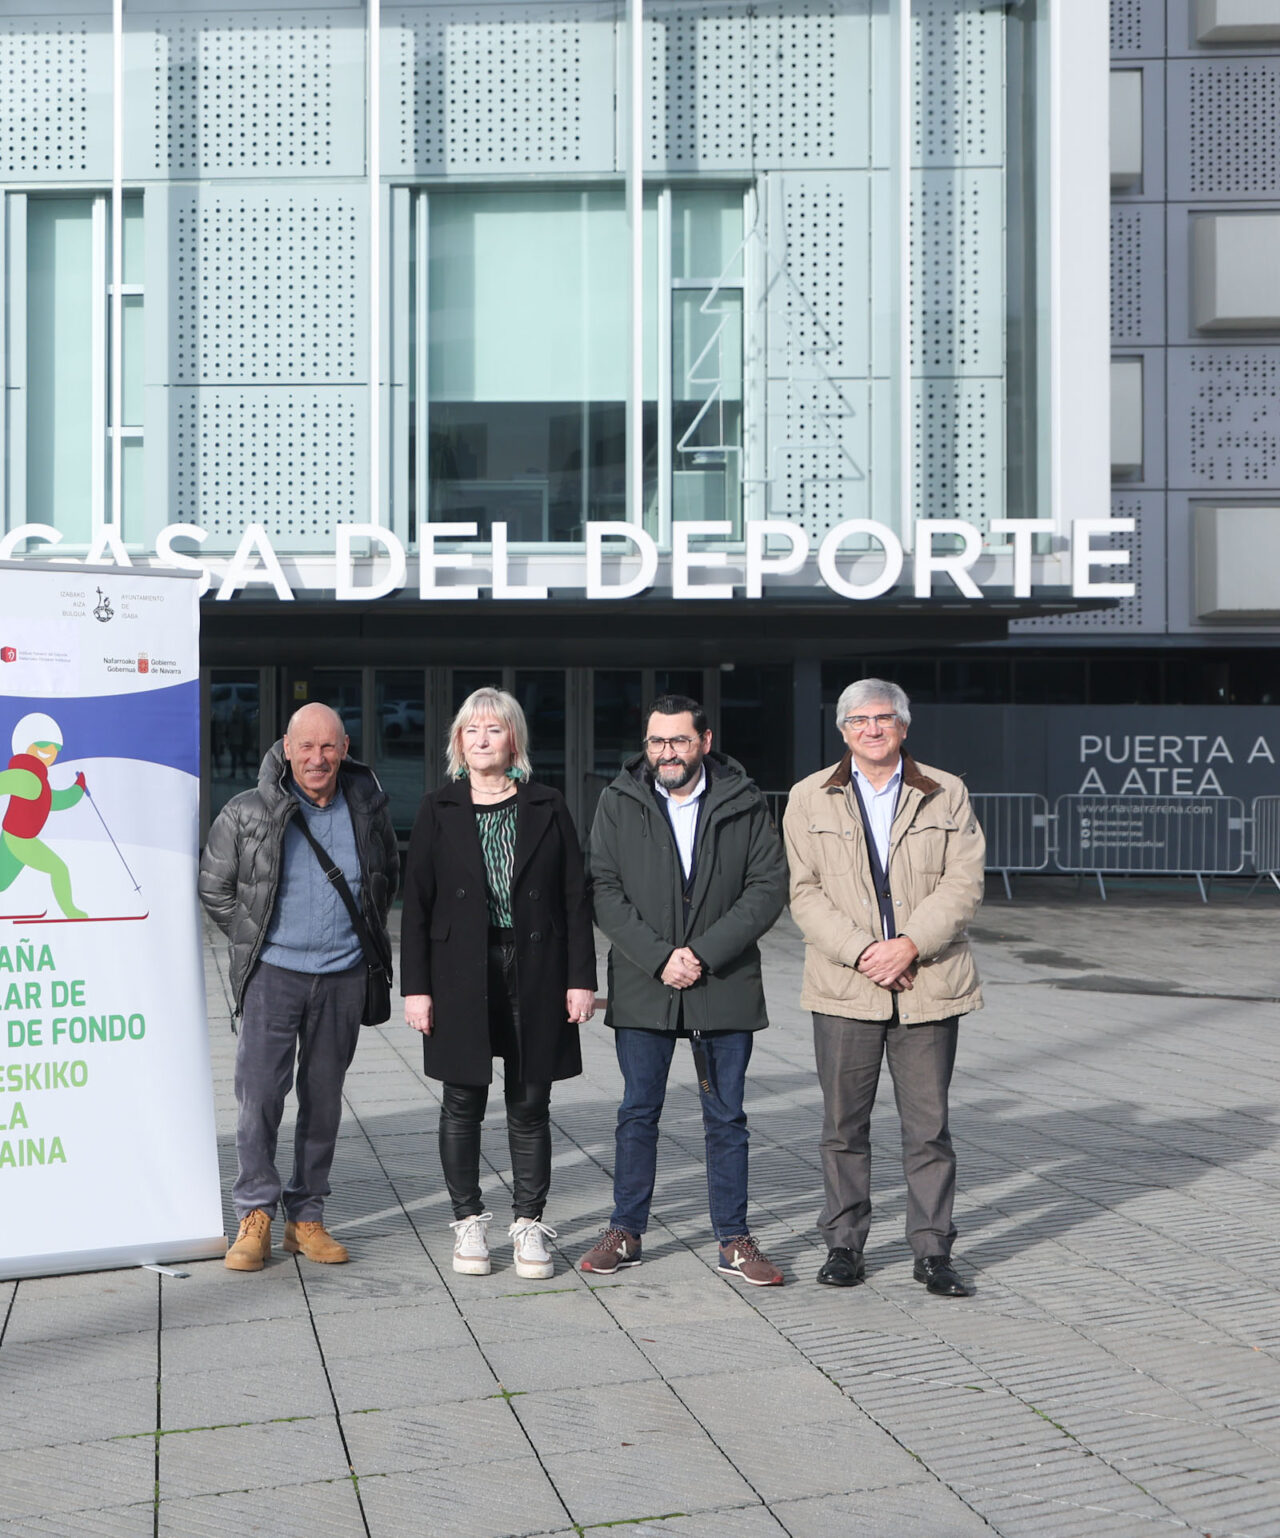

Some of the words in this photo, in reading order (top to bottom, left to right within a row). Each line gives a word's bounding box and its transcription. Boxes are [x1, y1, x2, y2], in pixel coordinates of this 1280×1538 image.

[335, 521, 548, 601] DEL
[586, 518, 1135, 600] DEPORTE
[121, 594, 164, 602] AYUNTAMIENTO
[103, 657, 136, 665] Nafarroako
[1080, 735, 1233, 763] PUERTA
[1247, 736, 1275, 763] A
[1078, 767, 1106, 795] A
[1120, 767, 1223, 796] ATEA
[52, 980, 86, 1008] DE
[8, 1019, 43, 1048] DE
[53, 1013, 146, 1045] FONDO
